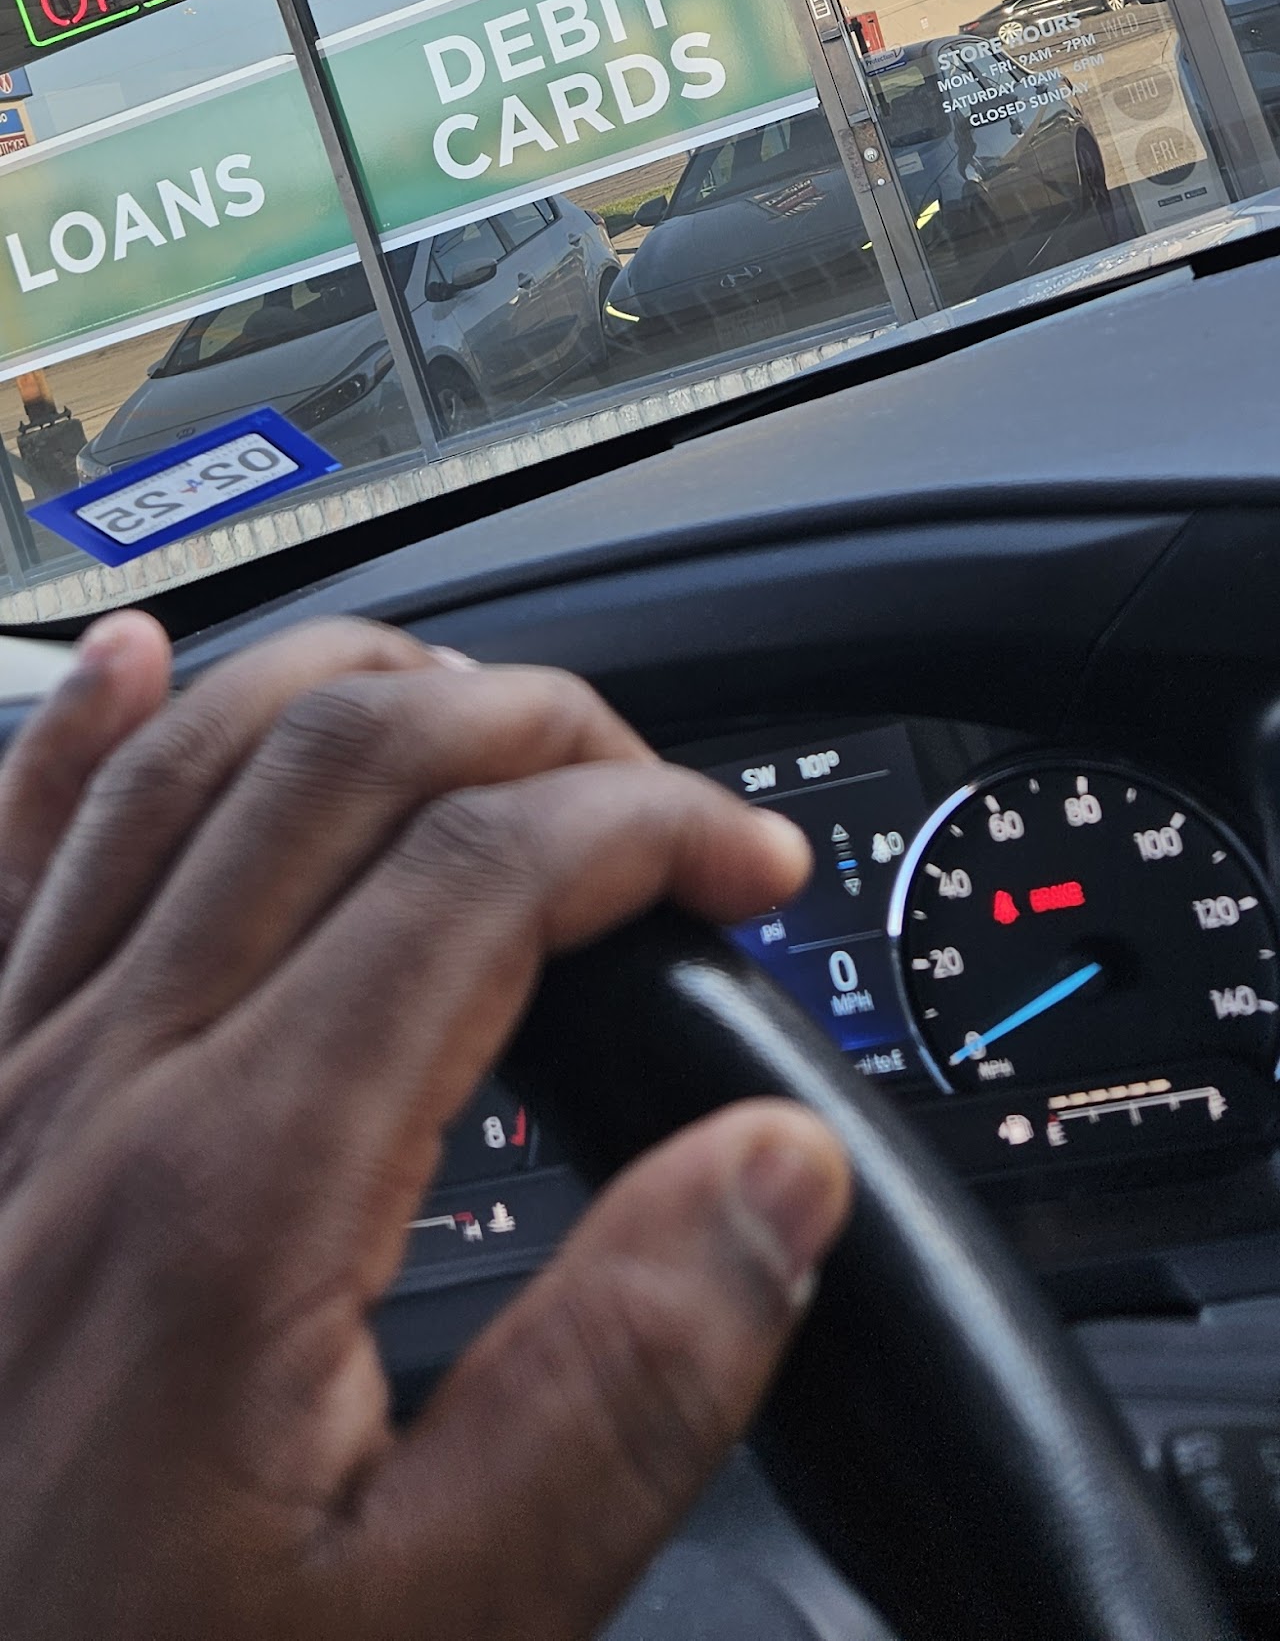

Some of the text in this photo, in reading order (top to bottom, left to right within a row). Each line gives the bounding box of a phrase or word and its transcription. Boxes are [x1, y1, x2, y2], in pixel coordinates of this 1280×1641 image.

[938, 36, 1003, 70] STORE
[1008, 12, 1082, 48] HOURS
[1102, 12, 1140, 40] WED
[937, 72, 979, 92] MON.
[989, 60, 1017, 78] FRI.
[1019, 47, 1053, 66] 9AM
[1063, 33, 1096, 53] 7PM
[942, 81, 1016, 113] SATURDAY
[1020, 68, 1061, 89] 10AM
[1073, 53, 1105, 73] 6PM
[1124, 77, 1159, 104] THU
[432, 31, 727, 181] CARDS
[969, 80, 1090, 127] CLOSED SUNDAY
[1150, 137, 1179, 164] FRI
[6, 154, 267, 294] LOANS
[742, 764, 776, 792] SW
[988, 810, 1025, 842] 60
[1064, 794, 1102, 827] 80
[1133, 826, 1183, 861] 100
[938, 868, 972, 899] 40
[1192, 895, 1240, 930] 120
[760, 919, 786, 945] psi
[829, 950, 858, 992] 0
[929, 946, 964, 979] 20
[830, 989, 875, 1016] MPH
[1209, 984, 1258, 1020] 140
[977, 1058, 1016, 1082] MPH
[482, 1115, 506, 1149] 8
